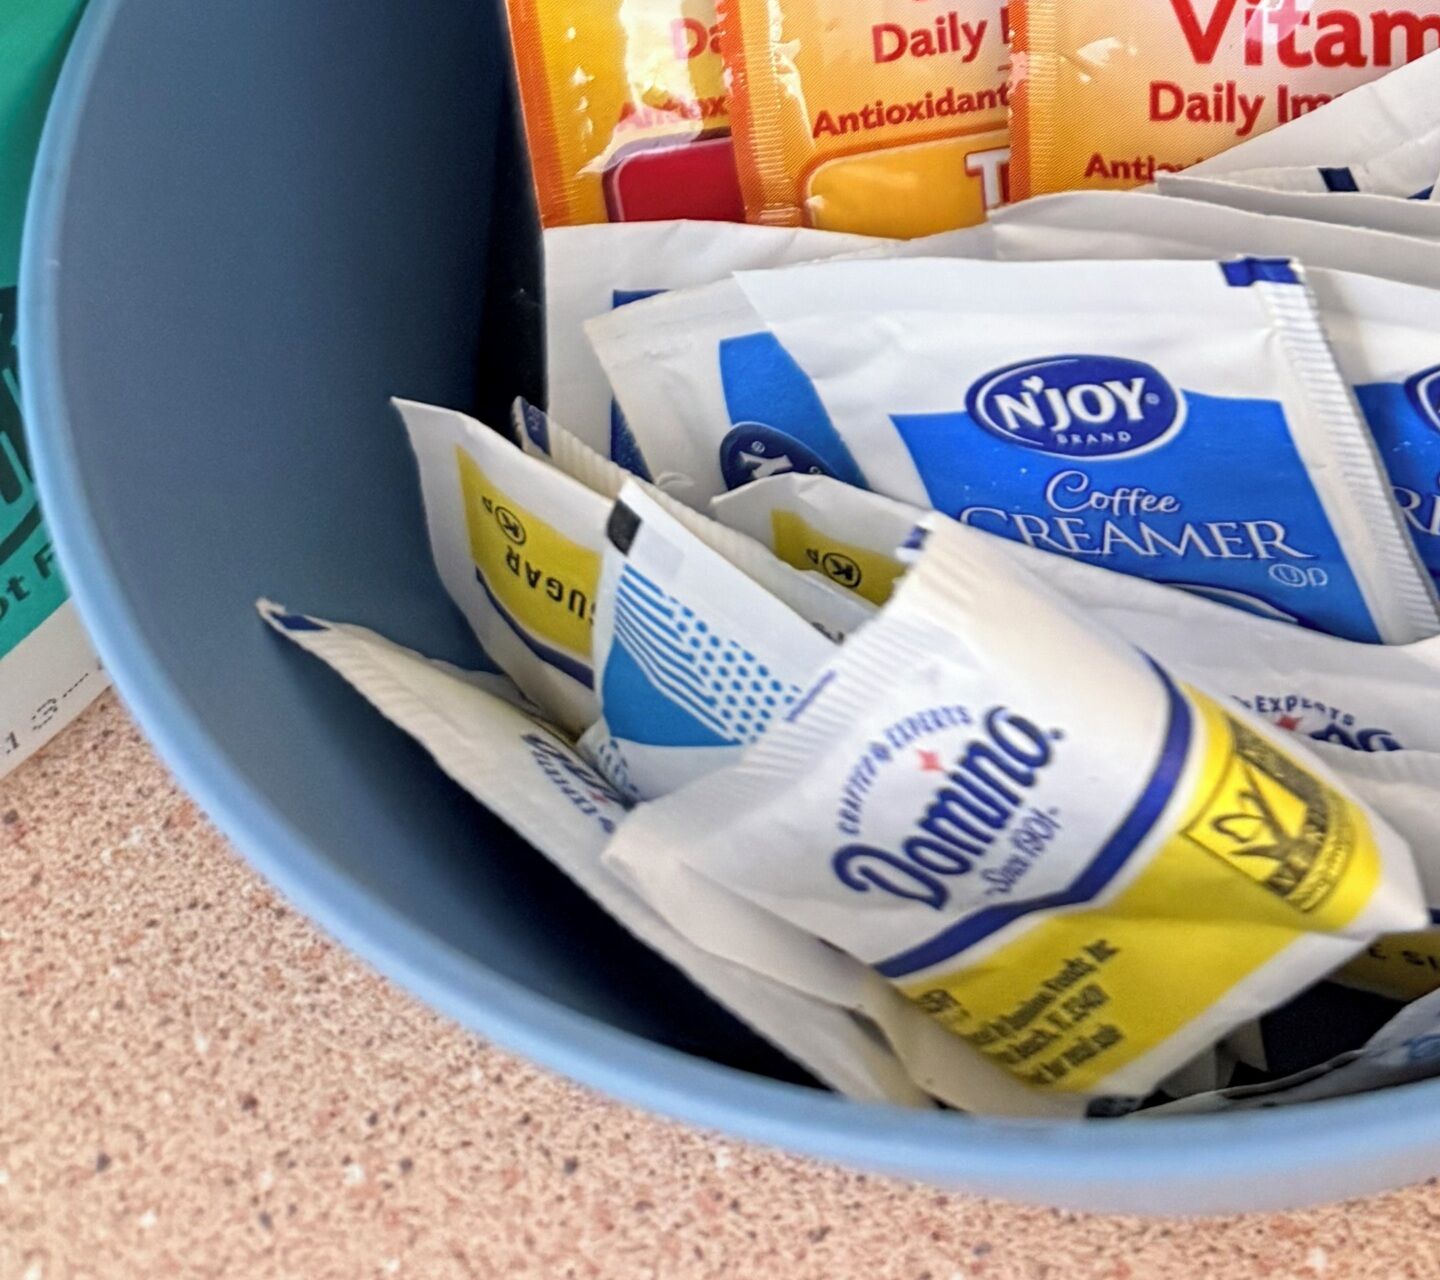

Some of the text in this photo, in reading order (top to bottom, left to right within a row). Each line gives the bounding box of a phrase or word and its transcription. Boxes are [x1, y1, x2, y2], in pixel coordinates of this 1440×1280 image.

[871, 10, 988, 65] Daily
[811, 83, 1010, 139] Antioxidant
[1148, 79, 1266, 138] Daily
[1056, 430, 1133, 445] BRAND
[1045, 469, 1181, 517] Coffee
[883, 704, 974, 750] EXPERTS
[831, 704, 1054, 911] Domino
